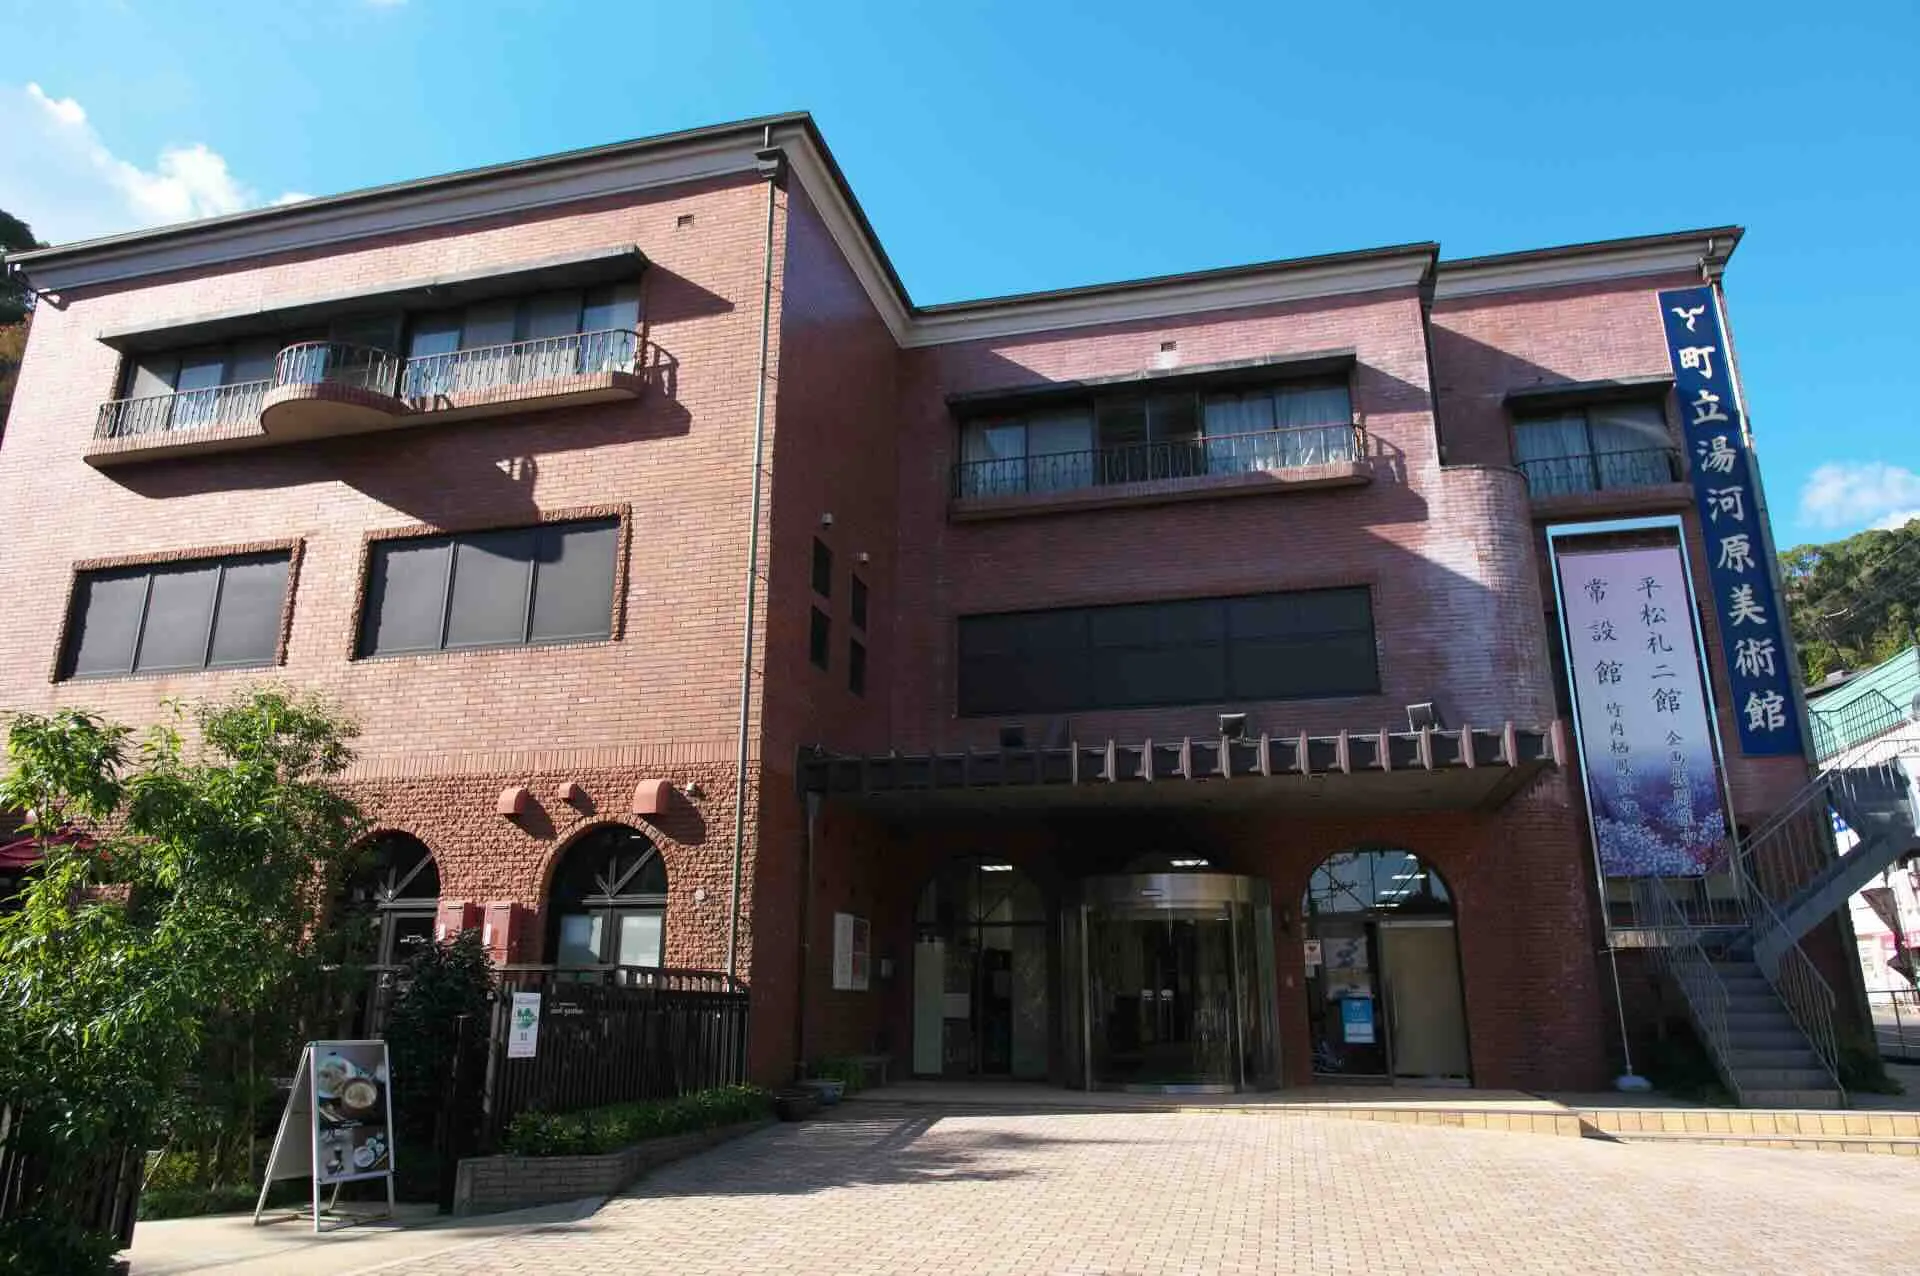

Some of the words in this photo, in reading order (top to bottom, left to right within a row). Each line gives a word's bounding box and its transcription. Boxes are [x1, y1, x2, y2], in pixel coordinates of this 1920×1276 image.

[1678, 346, 1786, 733] 町立湯河原美術館
[1584, 576, 1624, 686] 常設館
[1636, 575, 1684, 714] 平松礼二館
